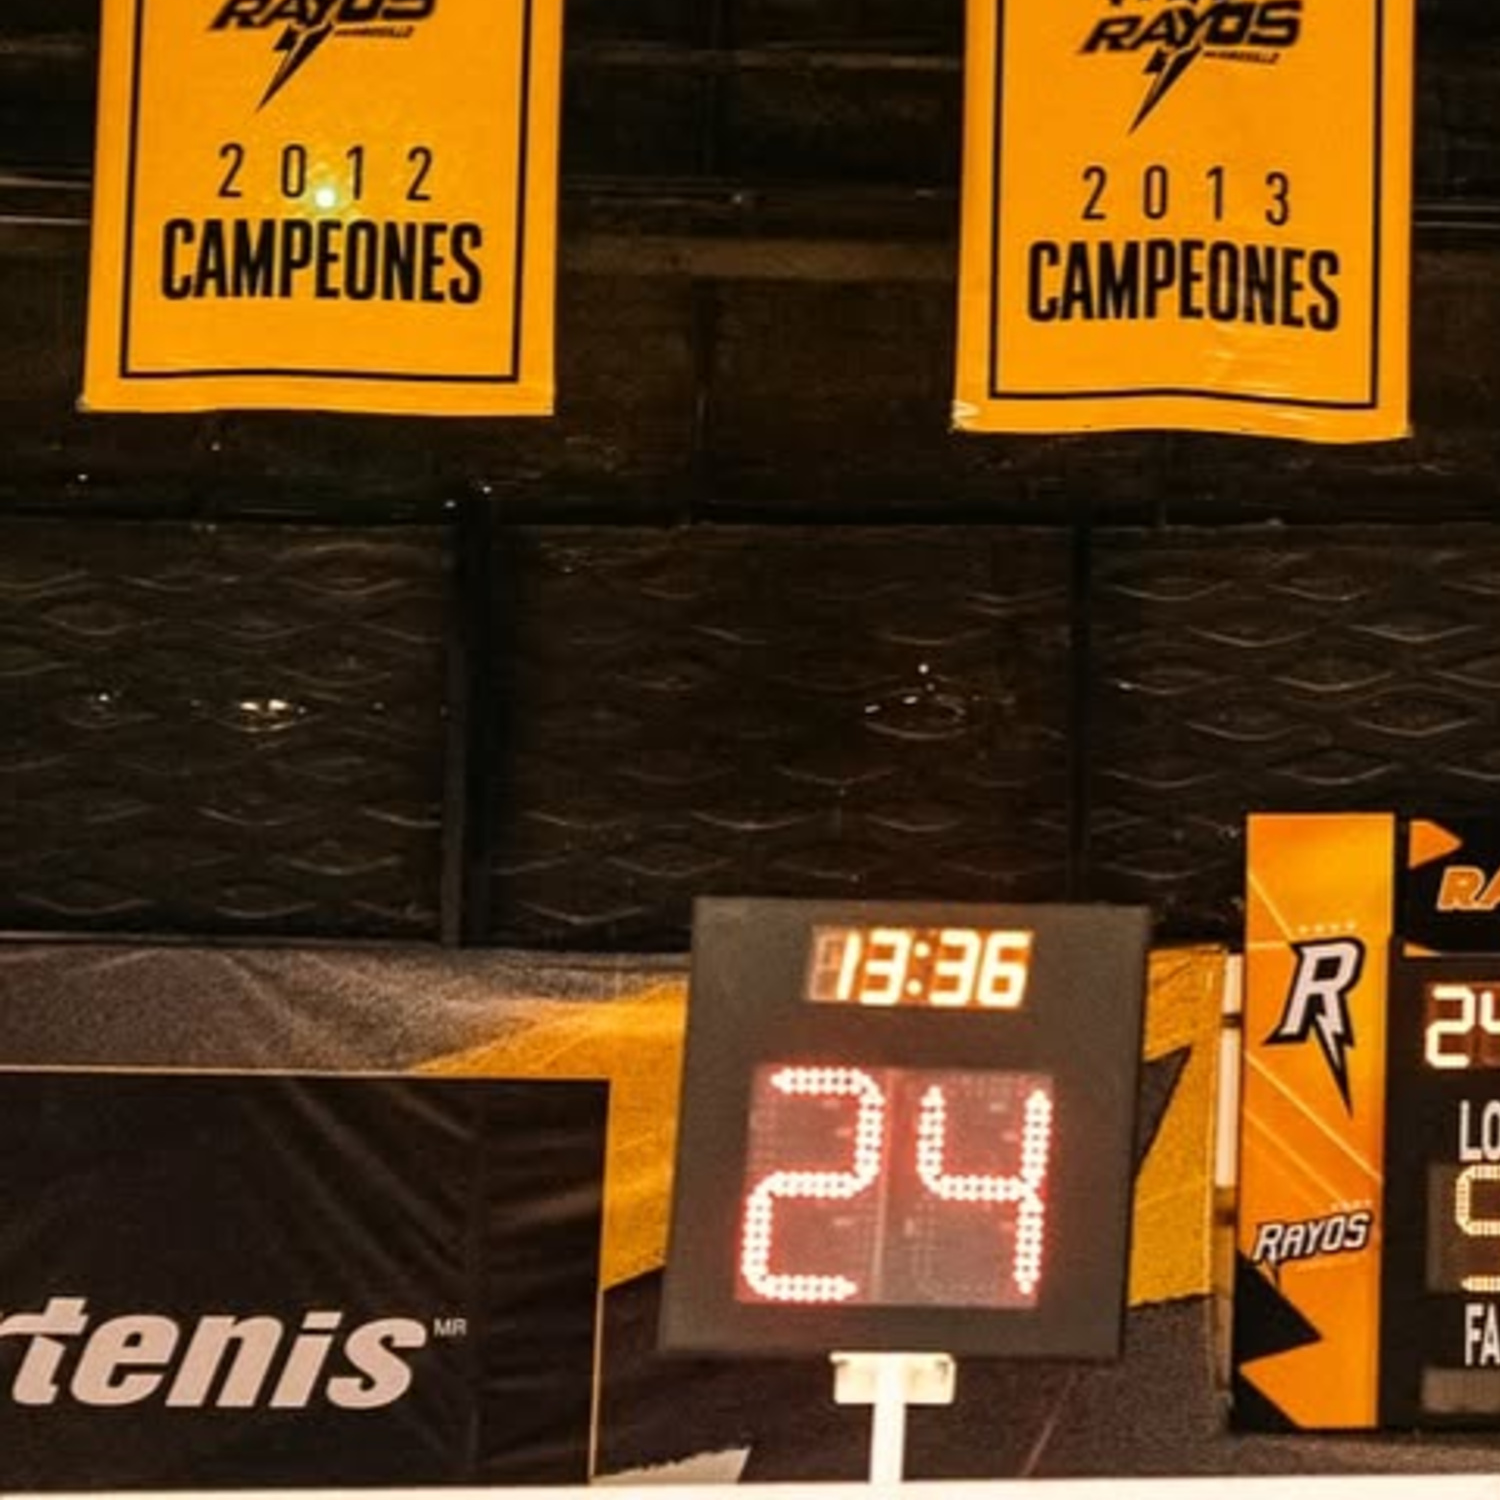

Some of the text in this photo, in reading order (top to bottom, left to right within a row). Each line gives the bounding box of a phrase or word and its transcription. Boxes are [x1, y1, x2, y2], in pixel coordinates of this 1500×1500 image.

[161, 218, 482, 304] CAMPEONES
[1028, 240, 1339, 332] CAMPEONES
[836, 929, 1034, 1007] 13:36
[742, 1068, 1052, 1301] 24
[1252, 1211, 1373, 1266] RAYOS
[0, 1297, 467, 1410] tenis MR
